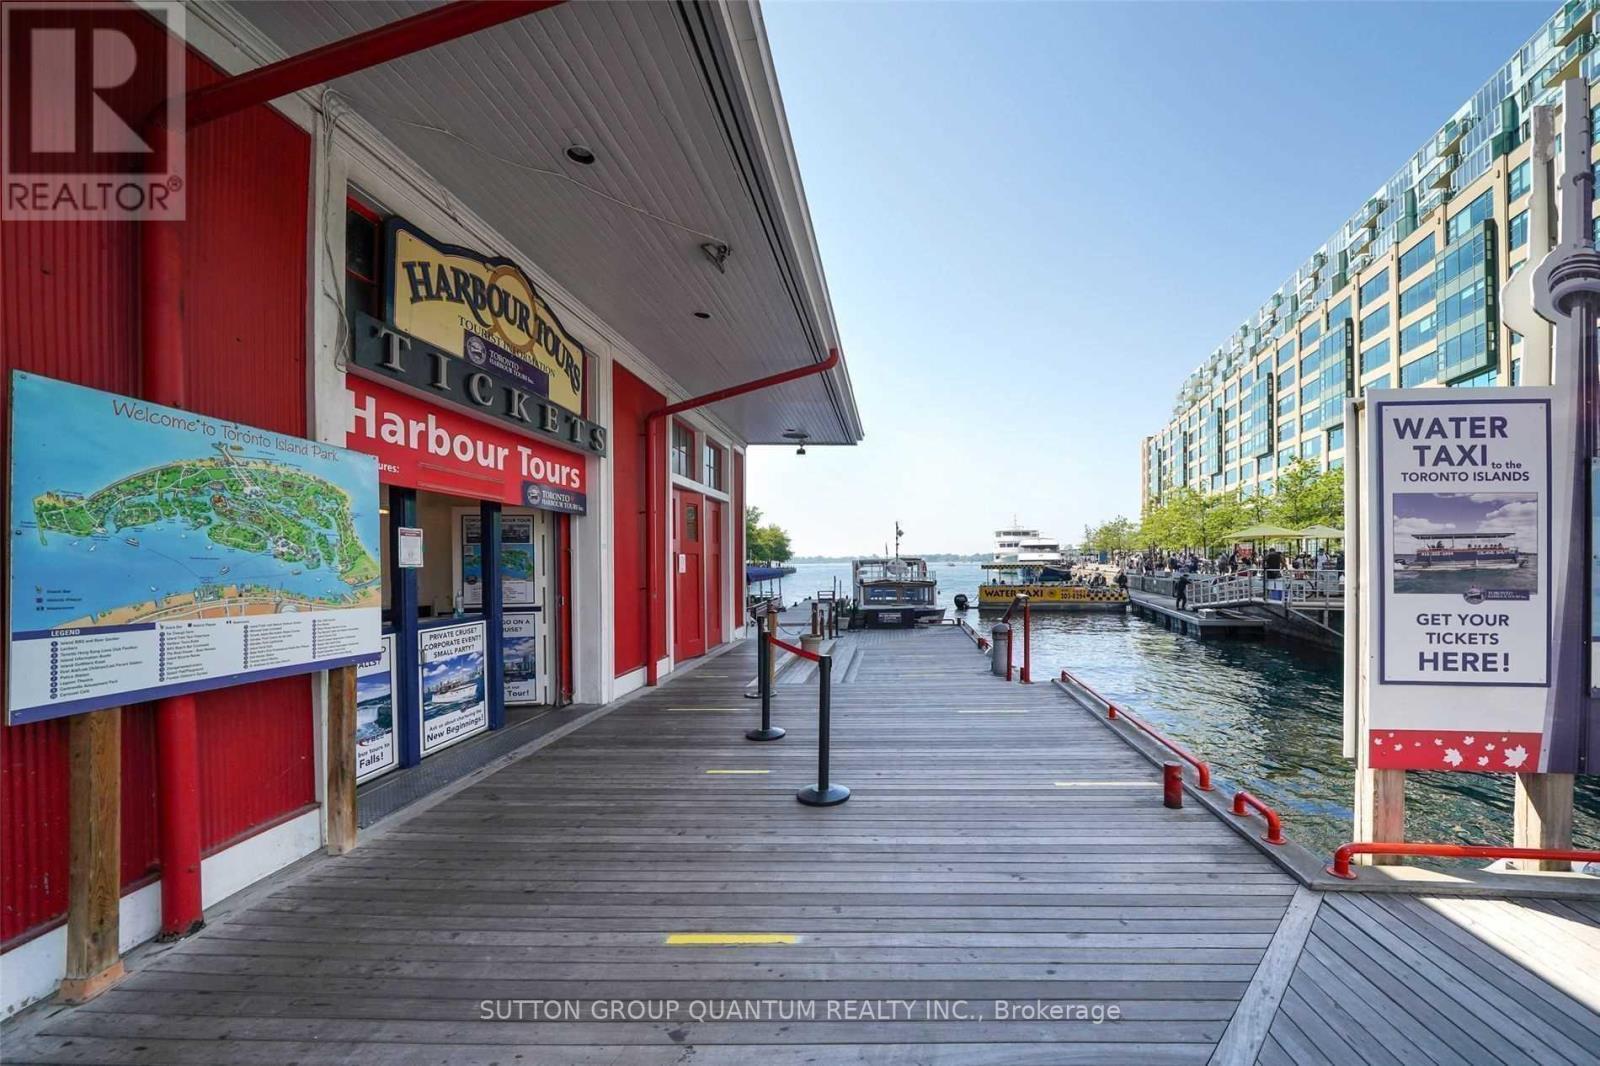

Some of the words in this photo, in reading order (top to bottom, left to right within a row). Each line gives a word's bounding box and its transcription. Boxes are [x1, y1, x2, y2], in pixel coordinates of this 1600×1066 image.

[402, 261, 535, 340] HARBOUR
[533, 312, 582, 396] TOURS
[488, 349, 519, 370] TORONTO
[378, 326, 607, 452] TICKETS
[112, 399, 198, 433] Welcome
[201, 420, 216, 436] to
[220, 424, 272, 449] Toronto
[275, 437, 309, 457] Island
[311, 445, 340, 462] Park
[1393, 416, 1508, 440] WATER
[347, 389, 510, 471] Harbour
[517, 445, 580, 489] Tours
[1413, 444, 1487, 467] TAXI
[1491, 461, 1502, 469] to
[1505, 460, 1522, 469] the
[1401, 472, 1469, 482] TORONTO
[1473, 471, 1530, 482] ISLANDS
[541, 490, 571, 502] TORONTO
[984, 589, 1017, 598] WATER
[1416, 613, 1452, 626] GET
[1457, 614, 1510, 626] YOUR
[50, 628, 81, 637] LEGEND
[429, 631, 454, 641] PRIVATE
[455, 627, 477, 637] CRUISE?
[1425, 632, 1500, 645] TICKETS
[424, 639, 461, 652] CORPORATE
[461, 634, 481, 644] EVENT?
[433, 649, 454, 659] SMALL
[454, 644, 475, 653] PARTY?
[1418, 652, 1510, 673] HERE!
[507, 689, 529, 697] Tour!
[426, 730, 445, 743] New
[446, 714, 484, 735] Beginnings!
[359, 752, 384, 769] Falls!
